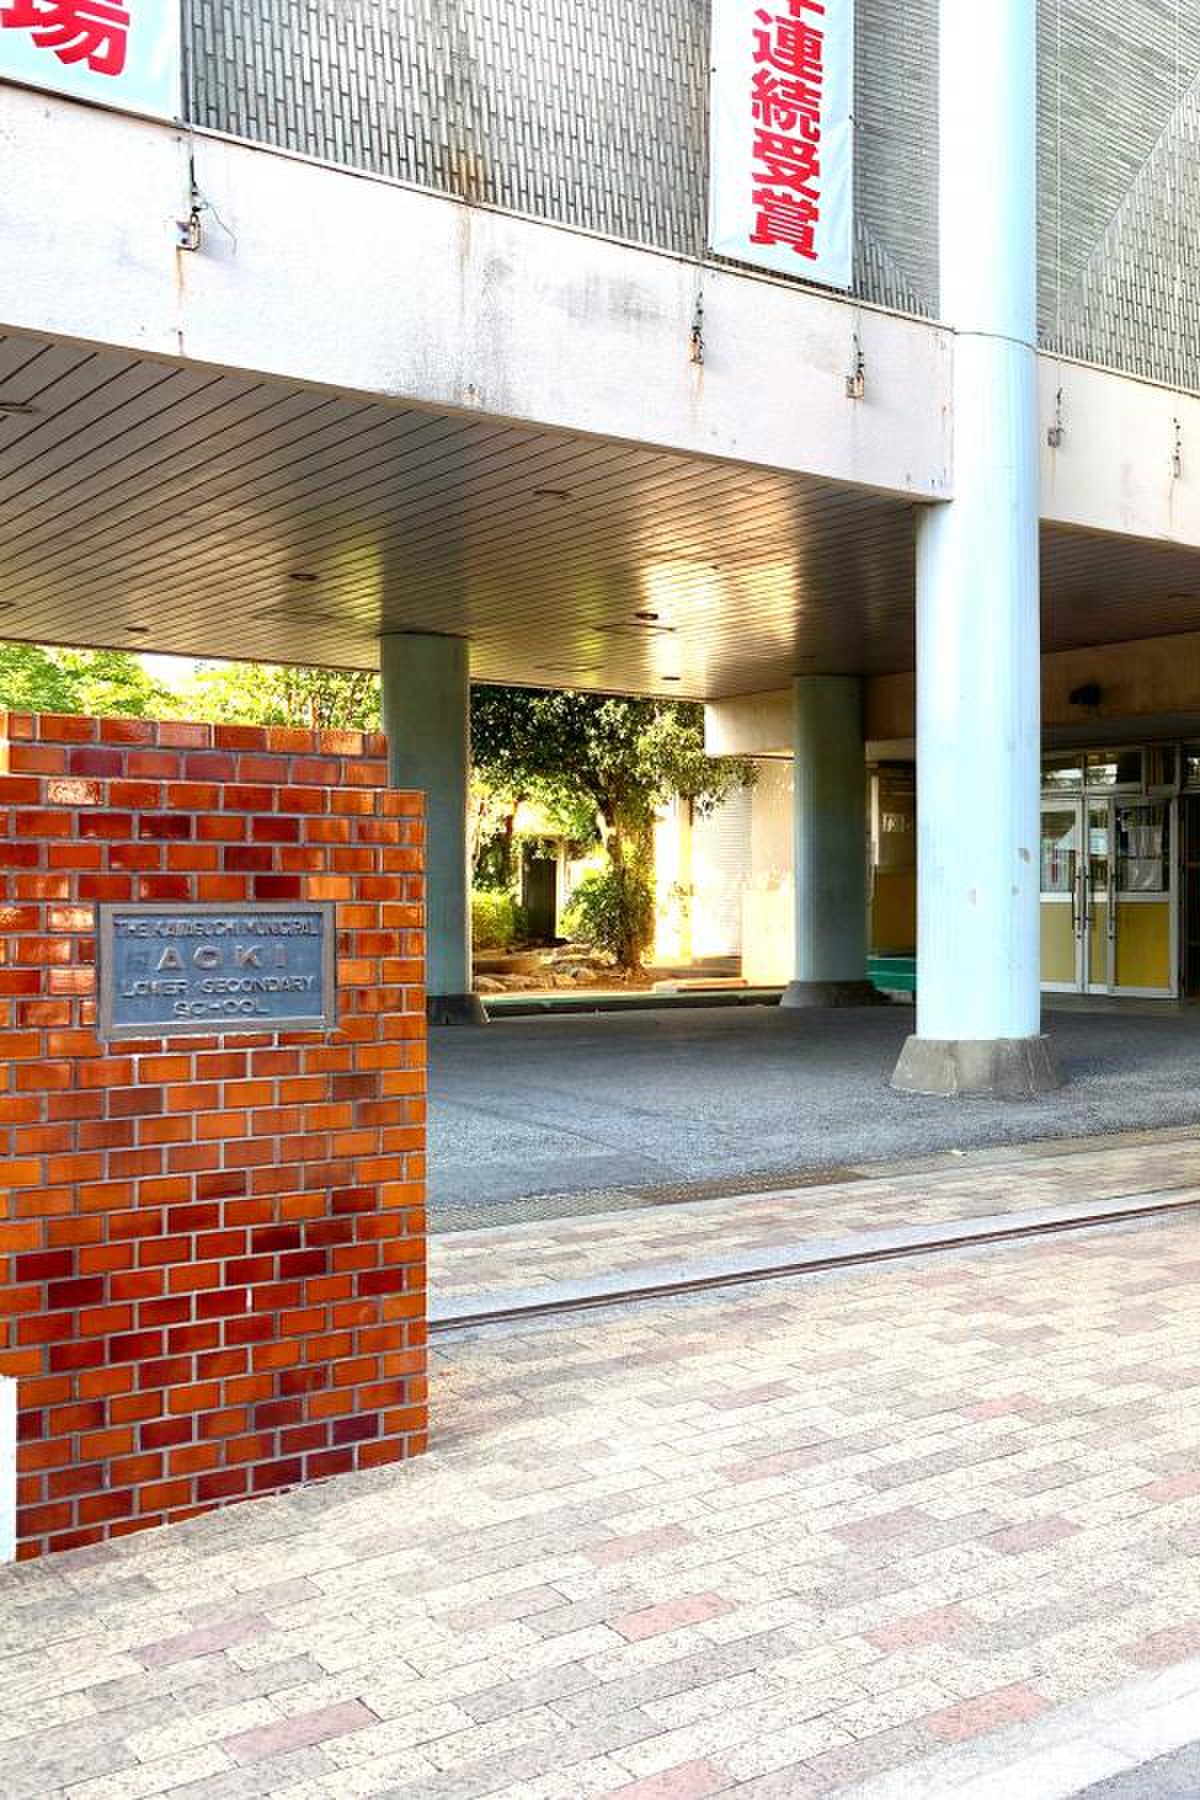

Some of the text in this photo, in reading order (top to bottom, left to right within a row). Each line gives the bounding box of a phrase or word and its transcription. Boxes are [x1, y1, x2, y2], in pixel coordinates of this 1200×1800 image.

[750, 0, 824, 261] 連続受賞
[157, 945, 289, 970] AOKI
[122, 975, 315, 998] LOWER SECONDARY
[174, 999, 270, 1021] SCHOOL
